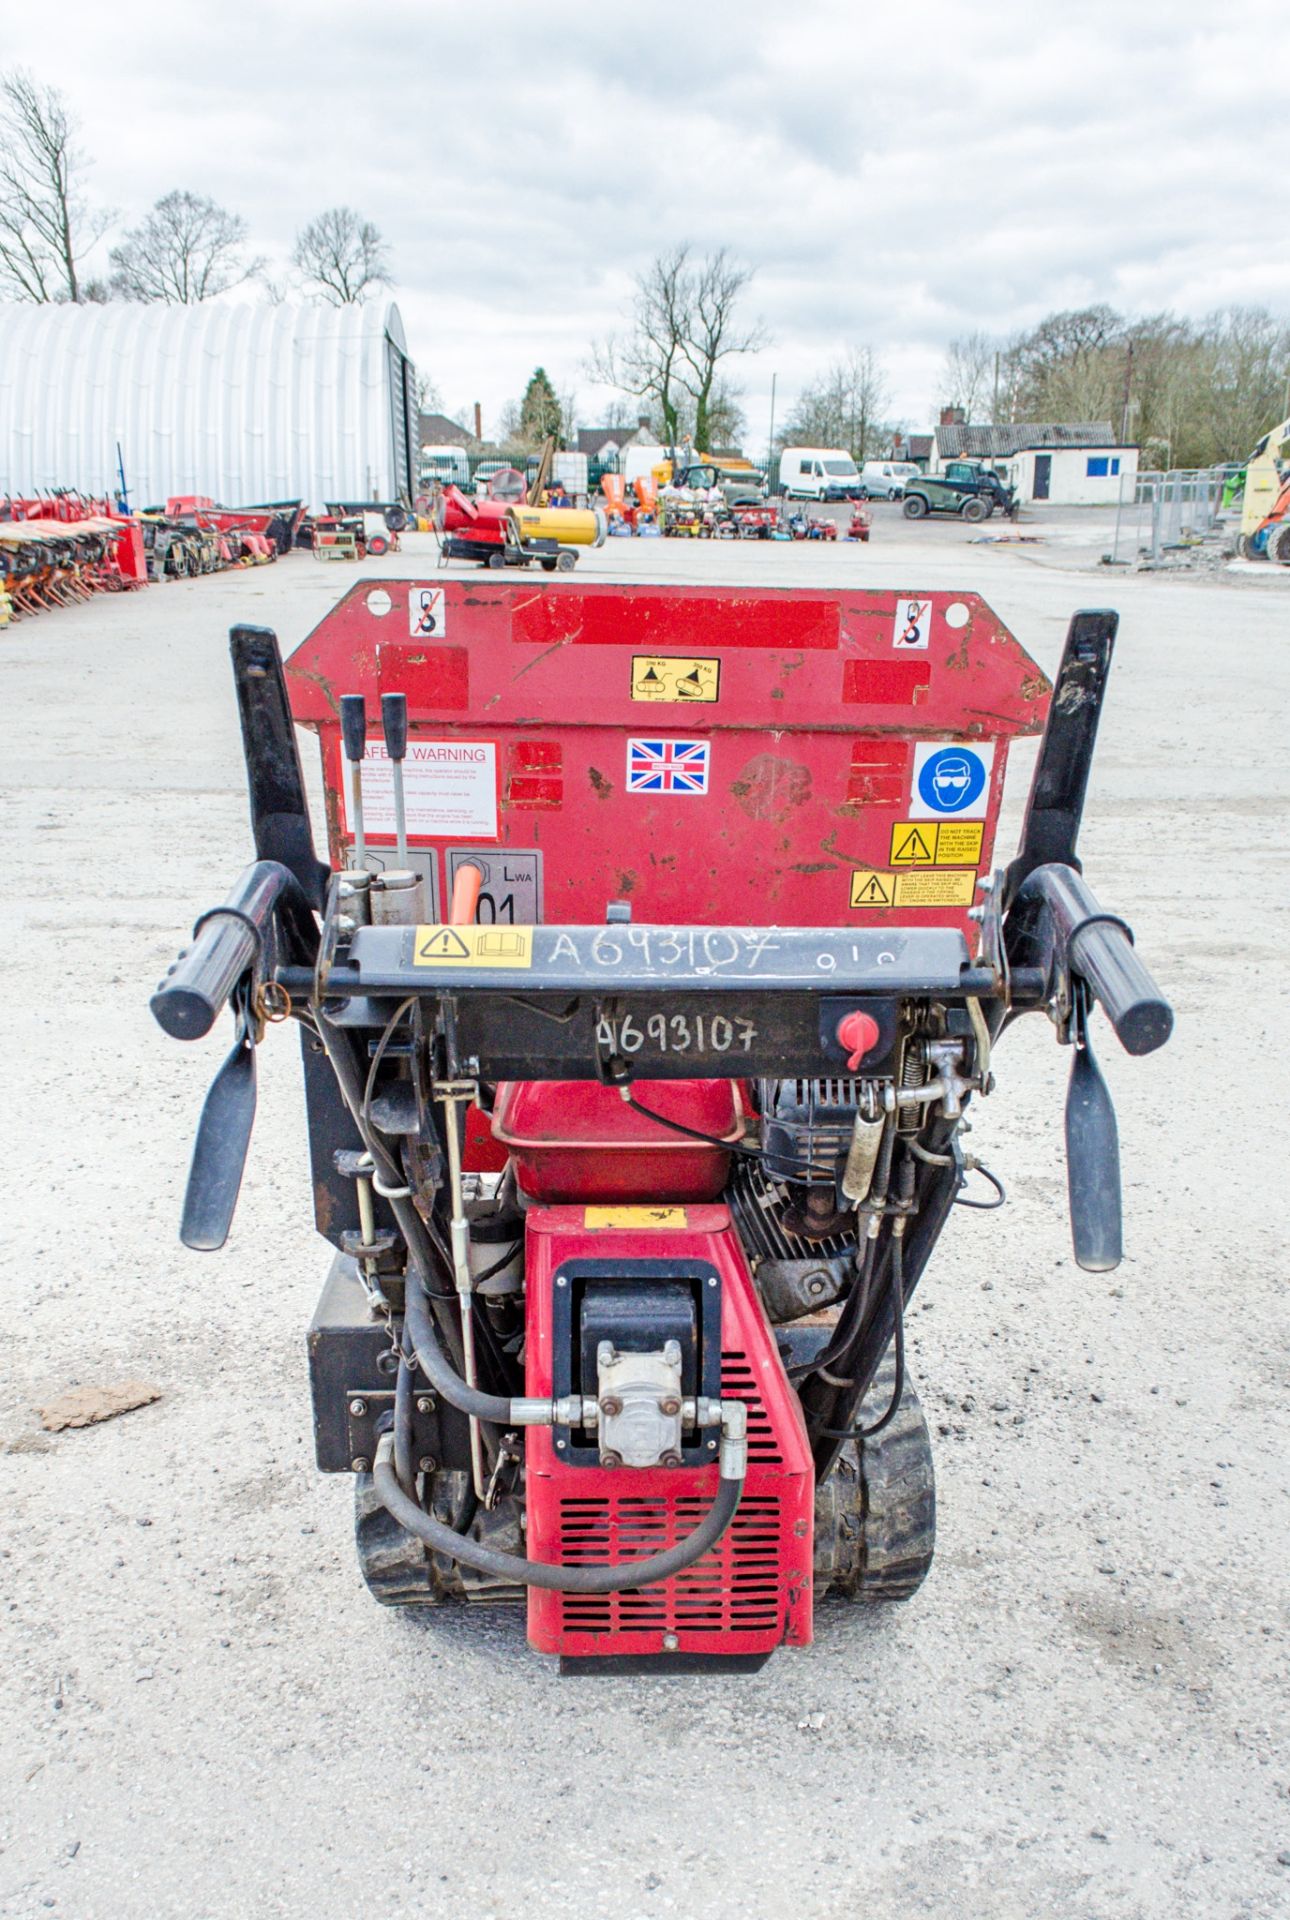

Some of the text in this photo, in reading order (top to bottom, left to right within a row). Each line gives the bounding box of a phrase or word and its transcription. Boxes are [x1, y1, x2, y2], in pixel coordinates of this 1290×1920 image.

[413, 748, 486, 762] WARNING
[548, 930, 780, 969] A693107
[596, 1014, 758, 1056] A693107
